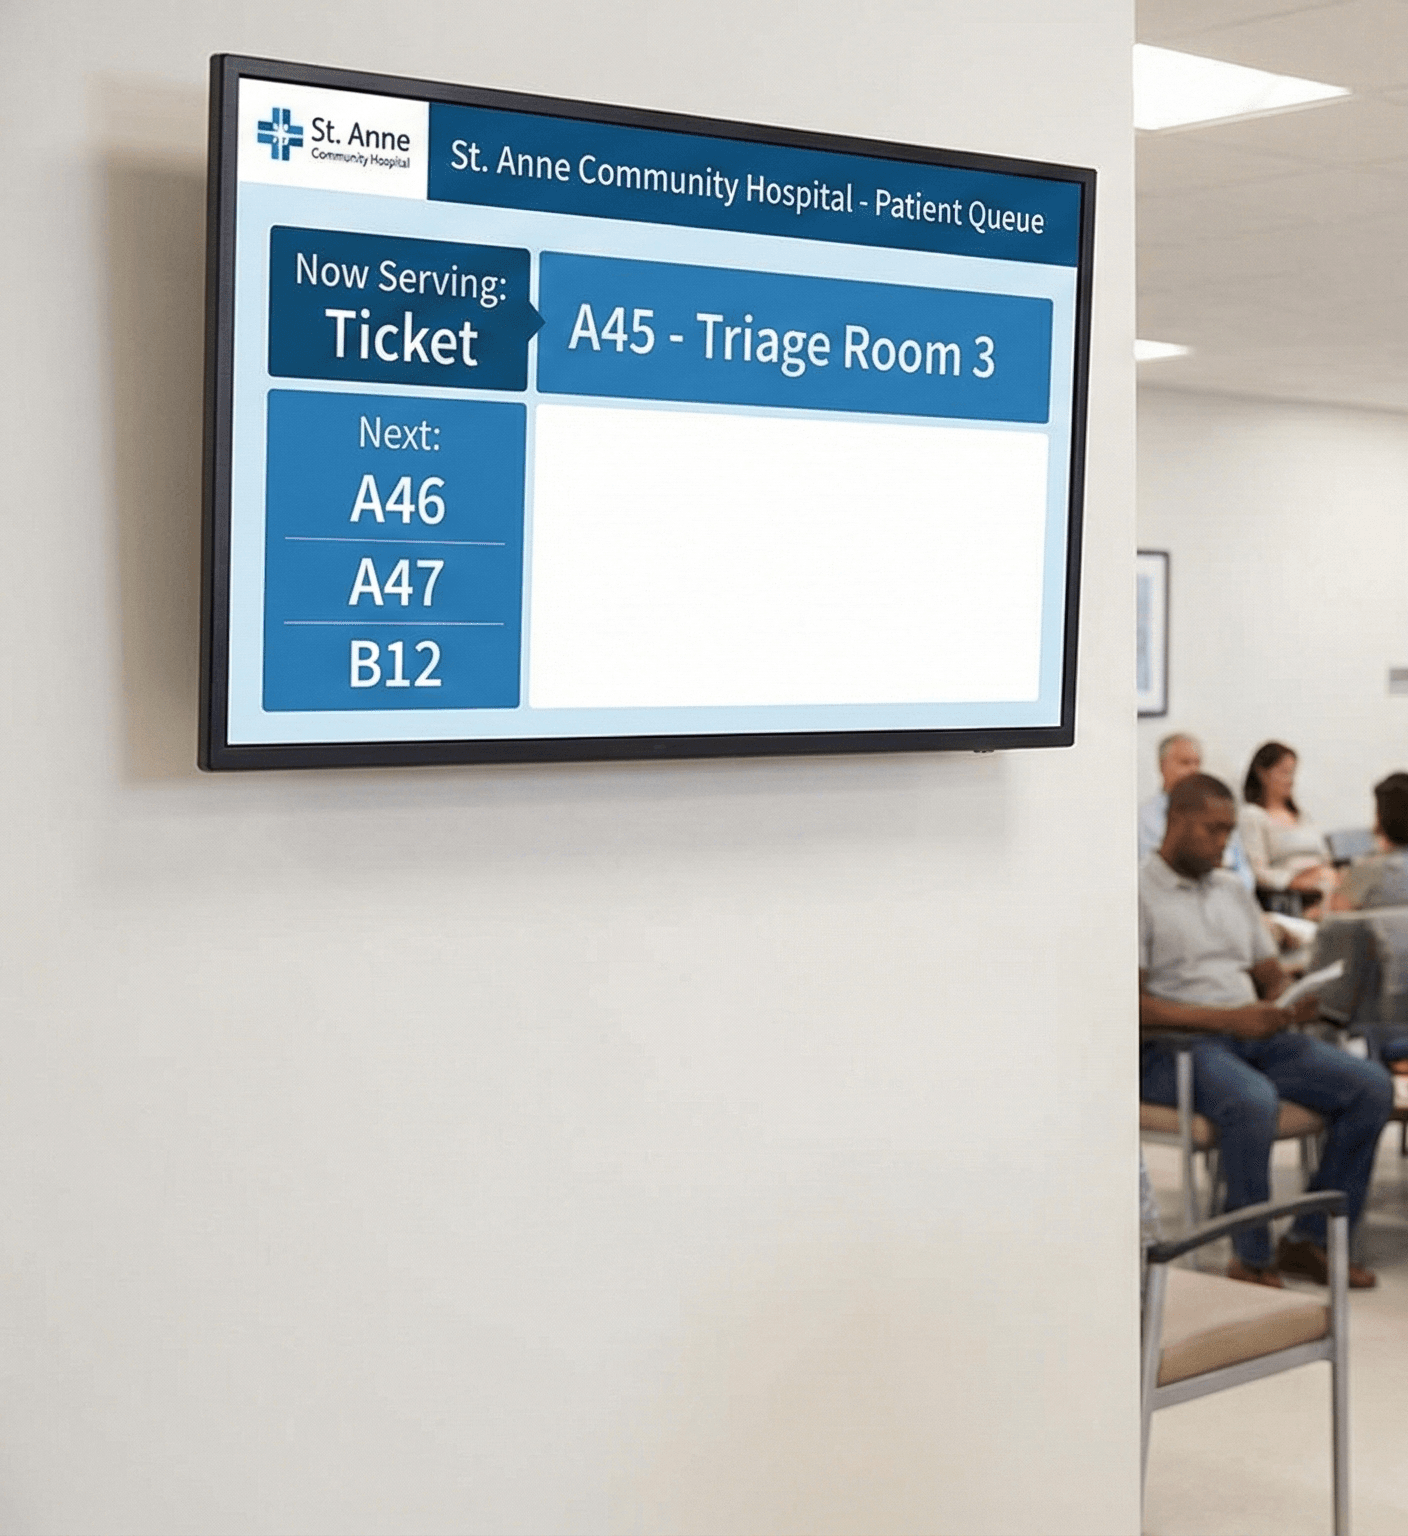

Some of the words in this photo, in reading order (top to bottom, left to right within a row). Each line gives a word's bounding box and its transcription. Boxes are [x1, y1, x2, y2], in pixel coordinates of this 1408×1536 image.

[311, 116, 341, 145] St.
[347, 121, 411, 152] Anne
[311, 147, 369, 167] Community
[451, 139, 488, 173] St.
[496, 145, 571, 182] Anne
[578, 154, 739, 207] Community
[747, 173, 853, 215] Hospital
[876, 188, 963, 226] Patient
[968, 200, 1044, 234] Queue
[296, 252, 370, 290] Now
[378, 259, 507, 309] Serving:
[324, 308, 478, 367] Ticket
[568, 303, 655, 355] A45
[696, 312, 831, 378] Triage
[844, 324, 961, 376] Room
[972, 335, 995, 378] 3
[360, 415, 440, 451] Next:
[350, 474, 445, 525] A46
[348, 557, 445, 606] A47
[350, 640, 442, 688] B12
